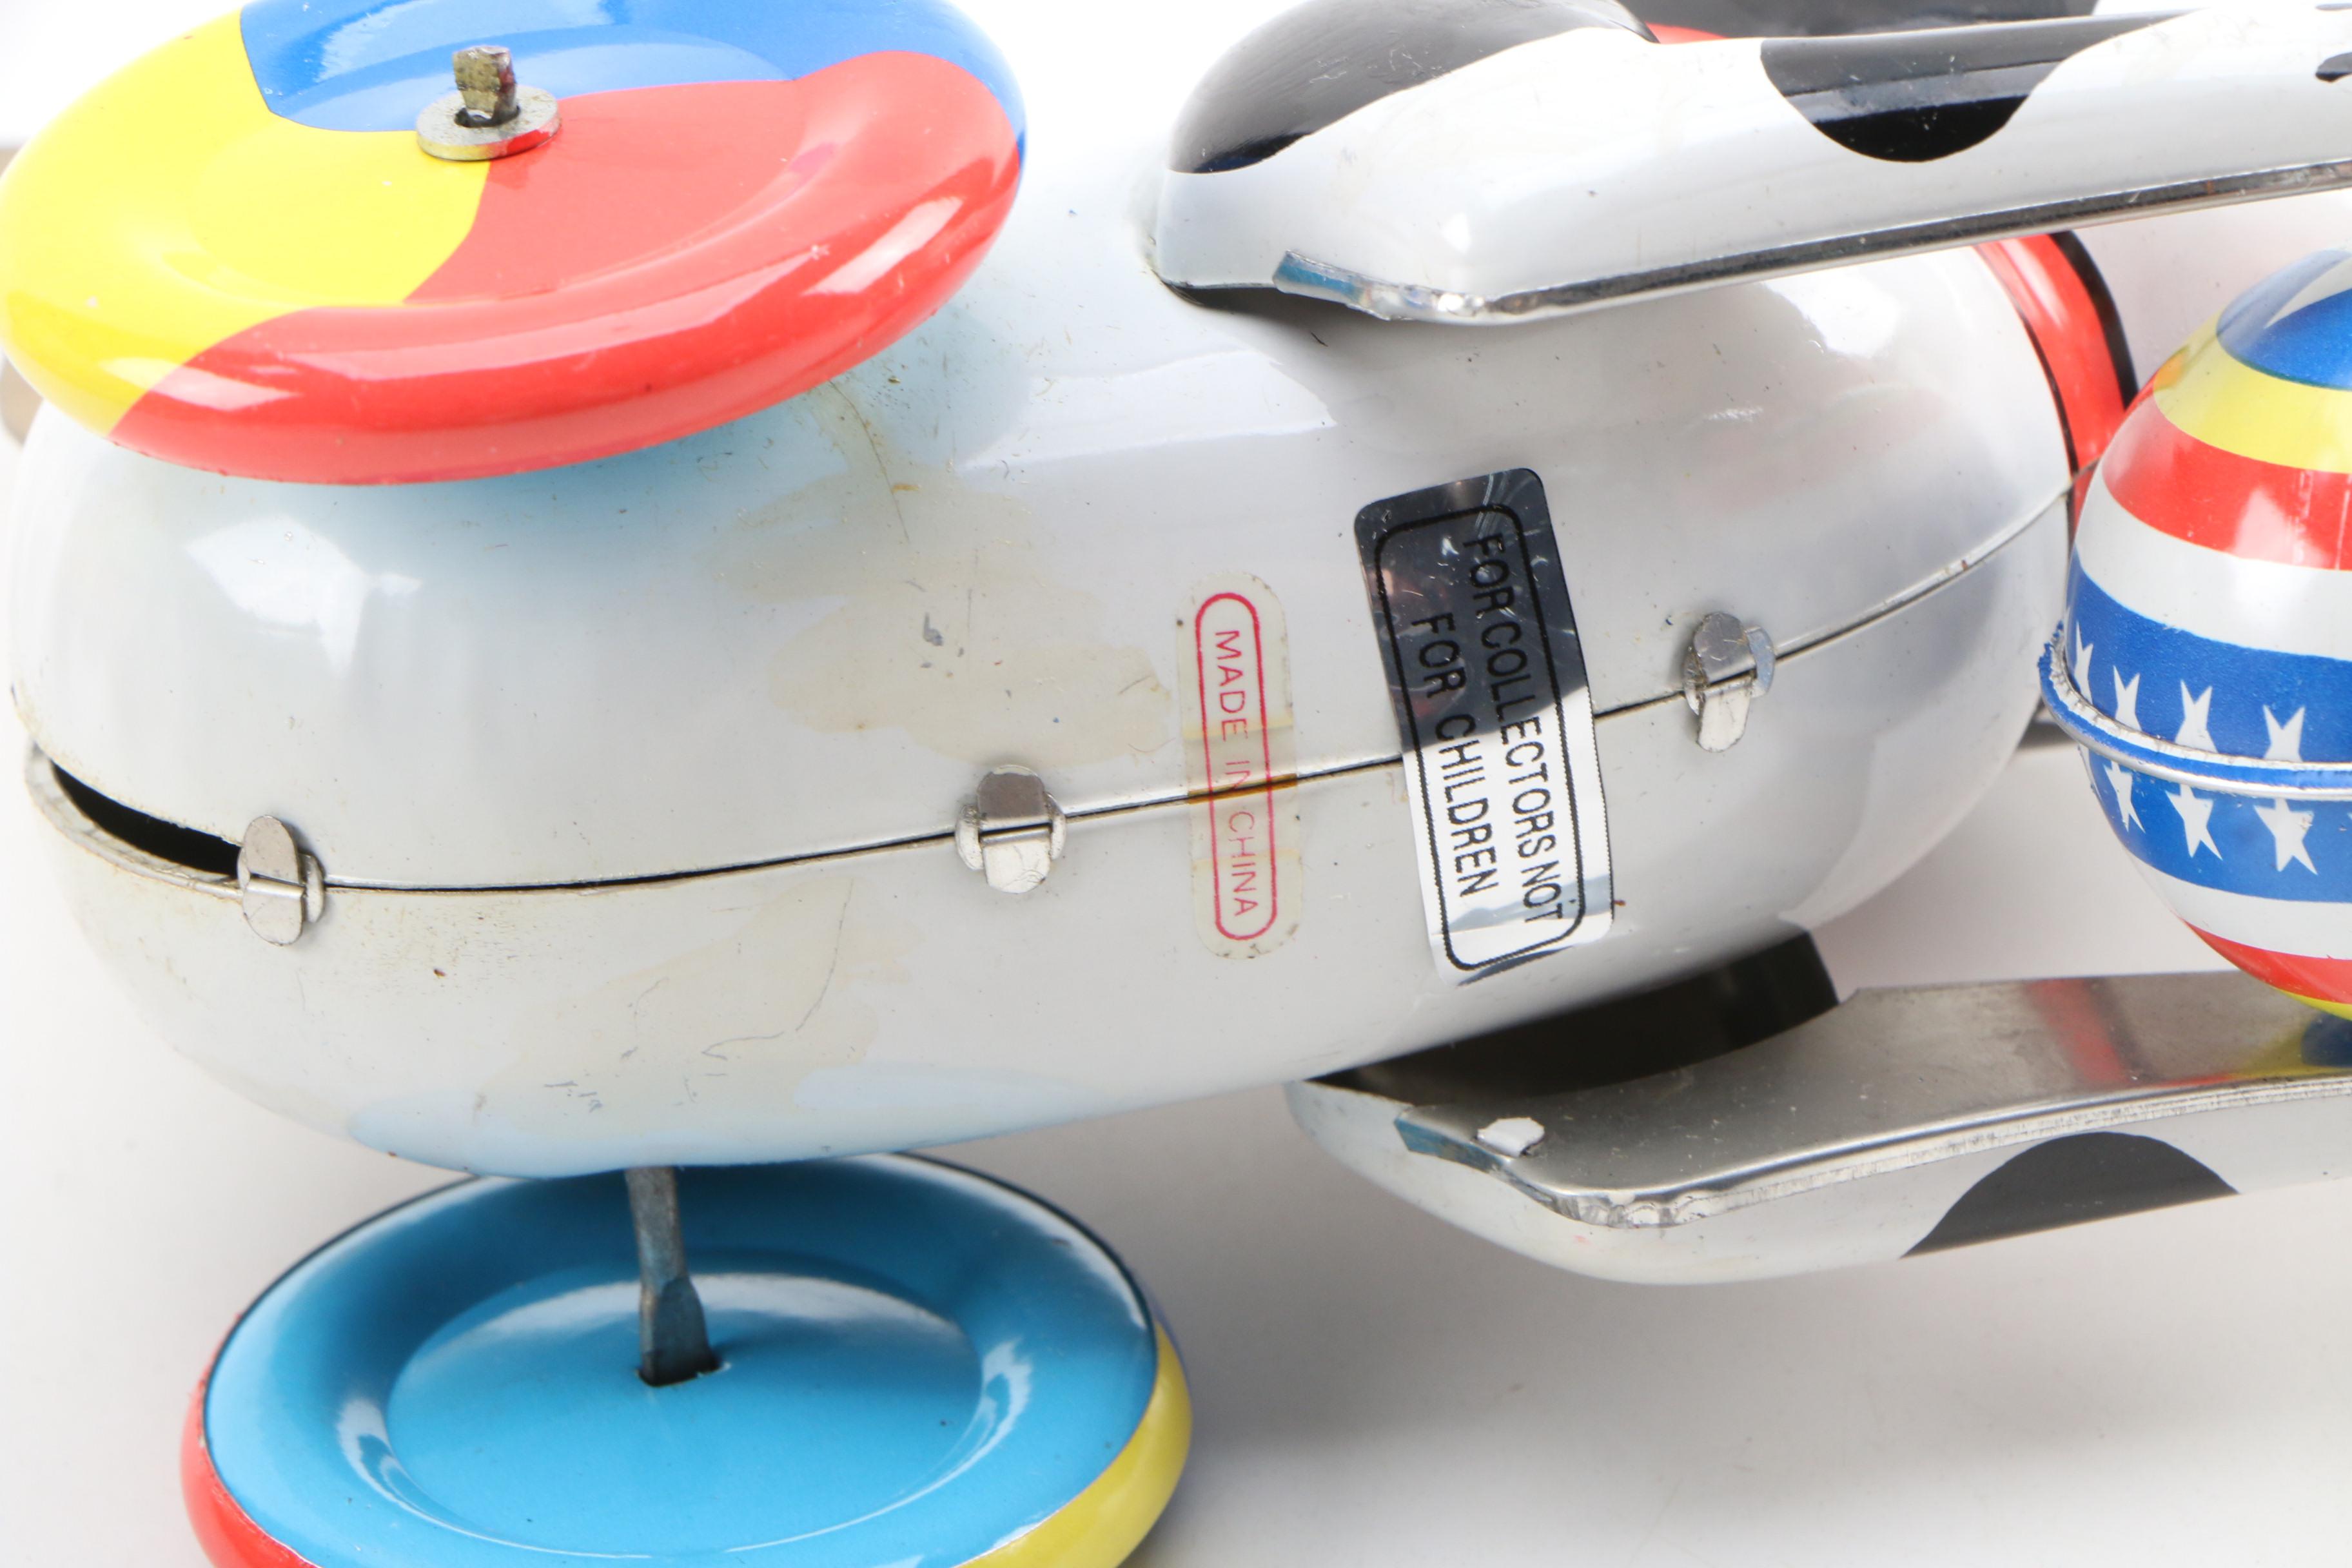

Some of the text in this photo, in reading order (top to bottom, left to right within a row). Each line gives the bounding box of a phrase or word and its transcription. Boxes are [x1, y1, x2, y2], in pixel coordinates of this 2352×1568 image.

[1215, 631, 1259, 916] MADE IN CHINA
[1411, 613, 1498, 896] FOR CHILDREN
[1464, 533, 1562, 923] FOR COLLECTORS NOT
